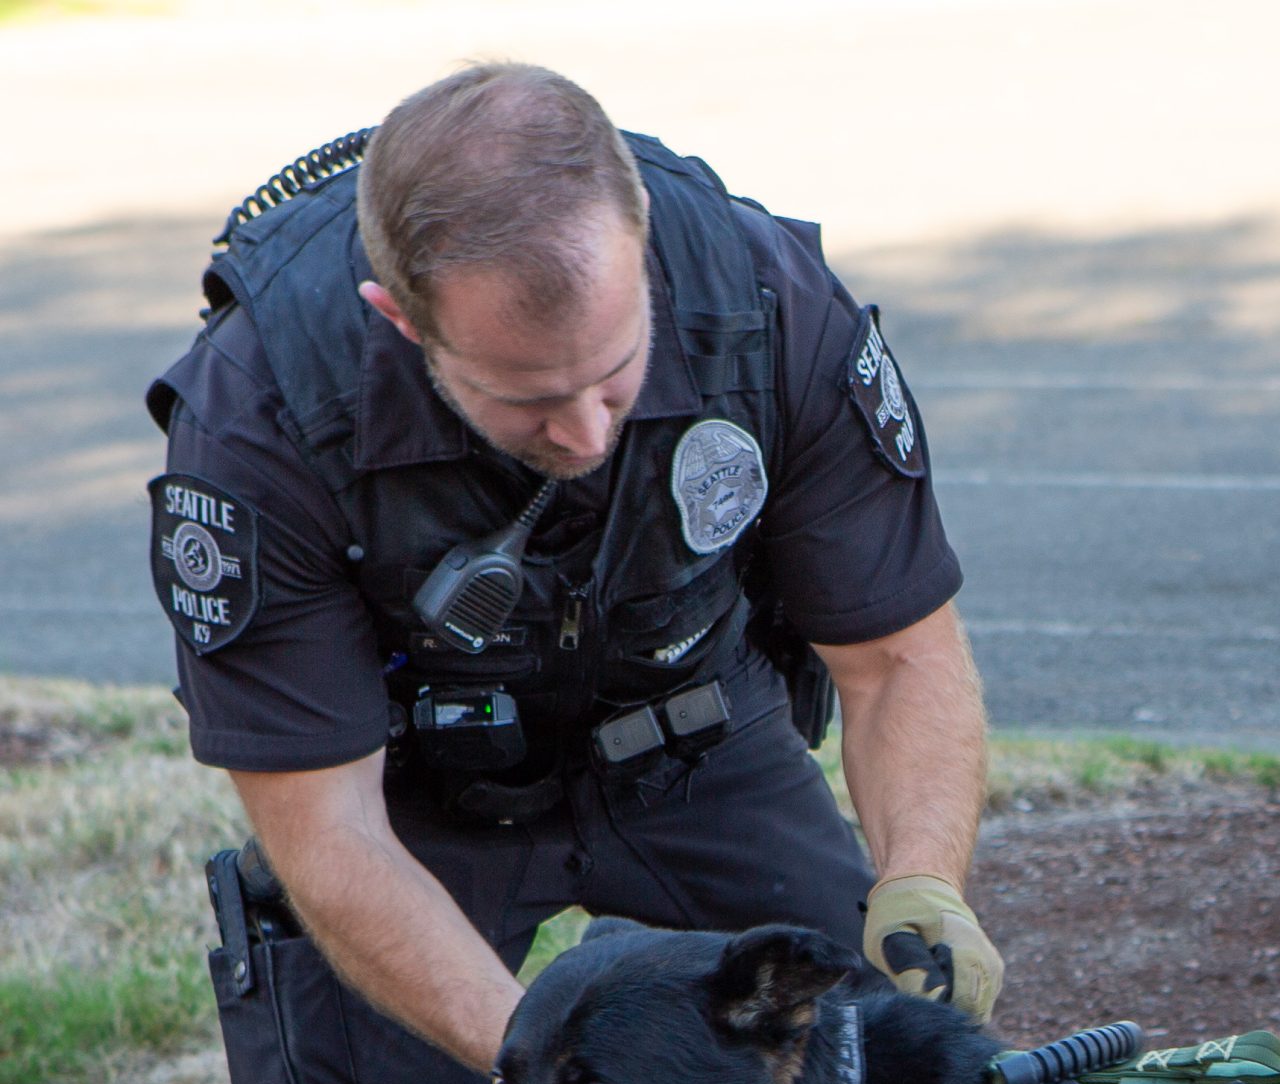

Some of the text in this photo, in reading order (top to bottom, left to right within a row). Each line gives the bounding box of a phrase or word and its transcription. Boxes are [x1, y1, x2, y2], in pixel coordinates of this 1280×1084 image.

[698, 466, 740, 495] SEATTLE
[165, 486, 235, 532] SEATTLE
[172, 584, 231, 625] POLICE
[193, 621, 211, 643] K9
